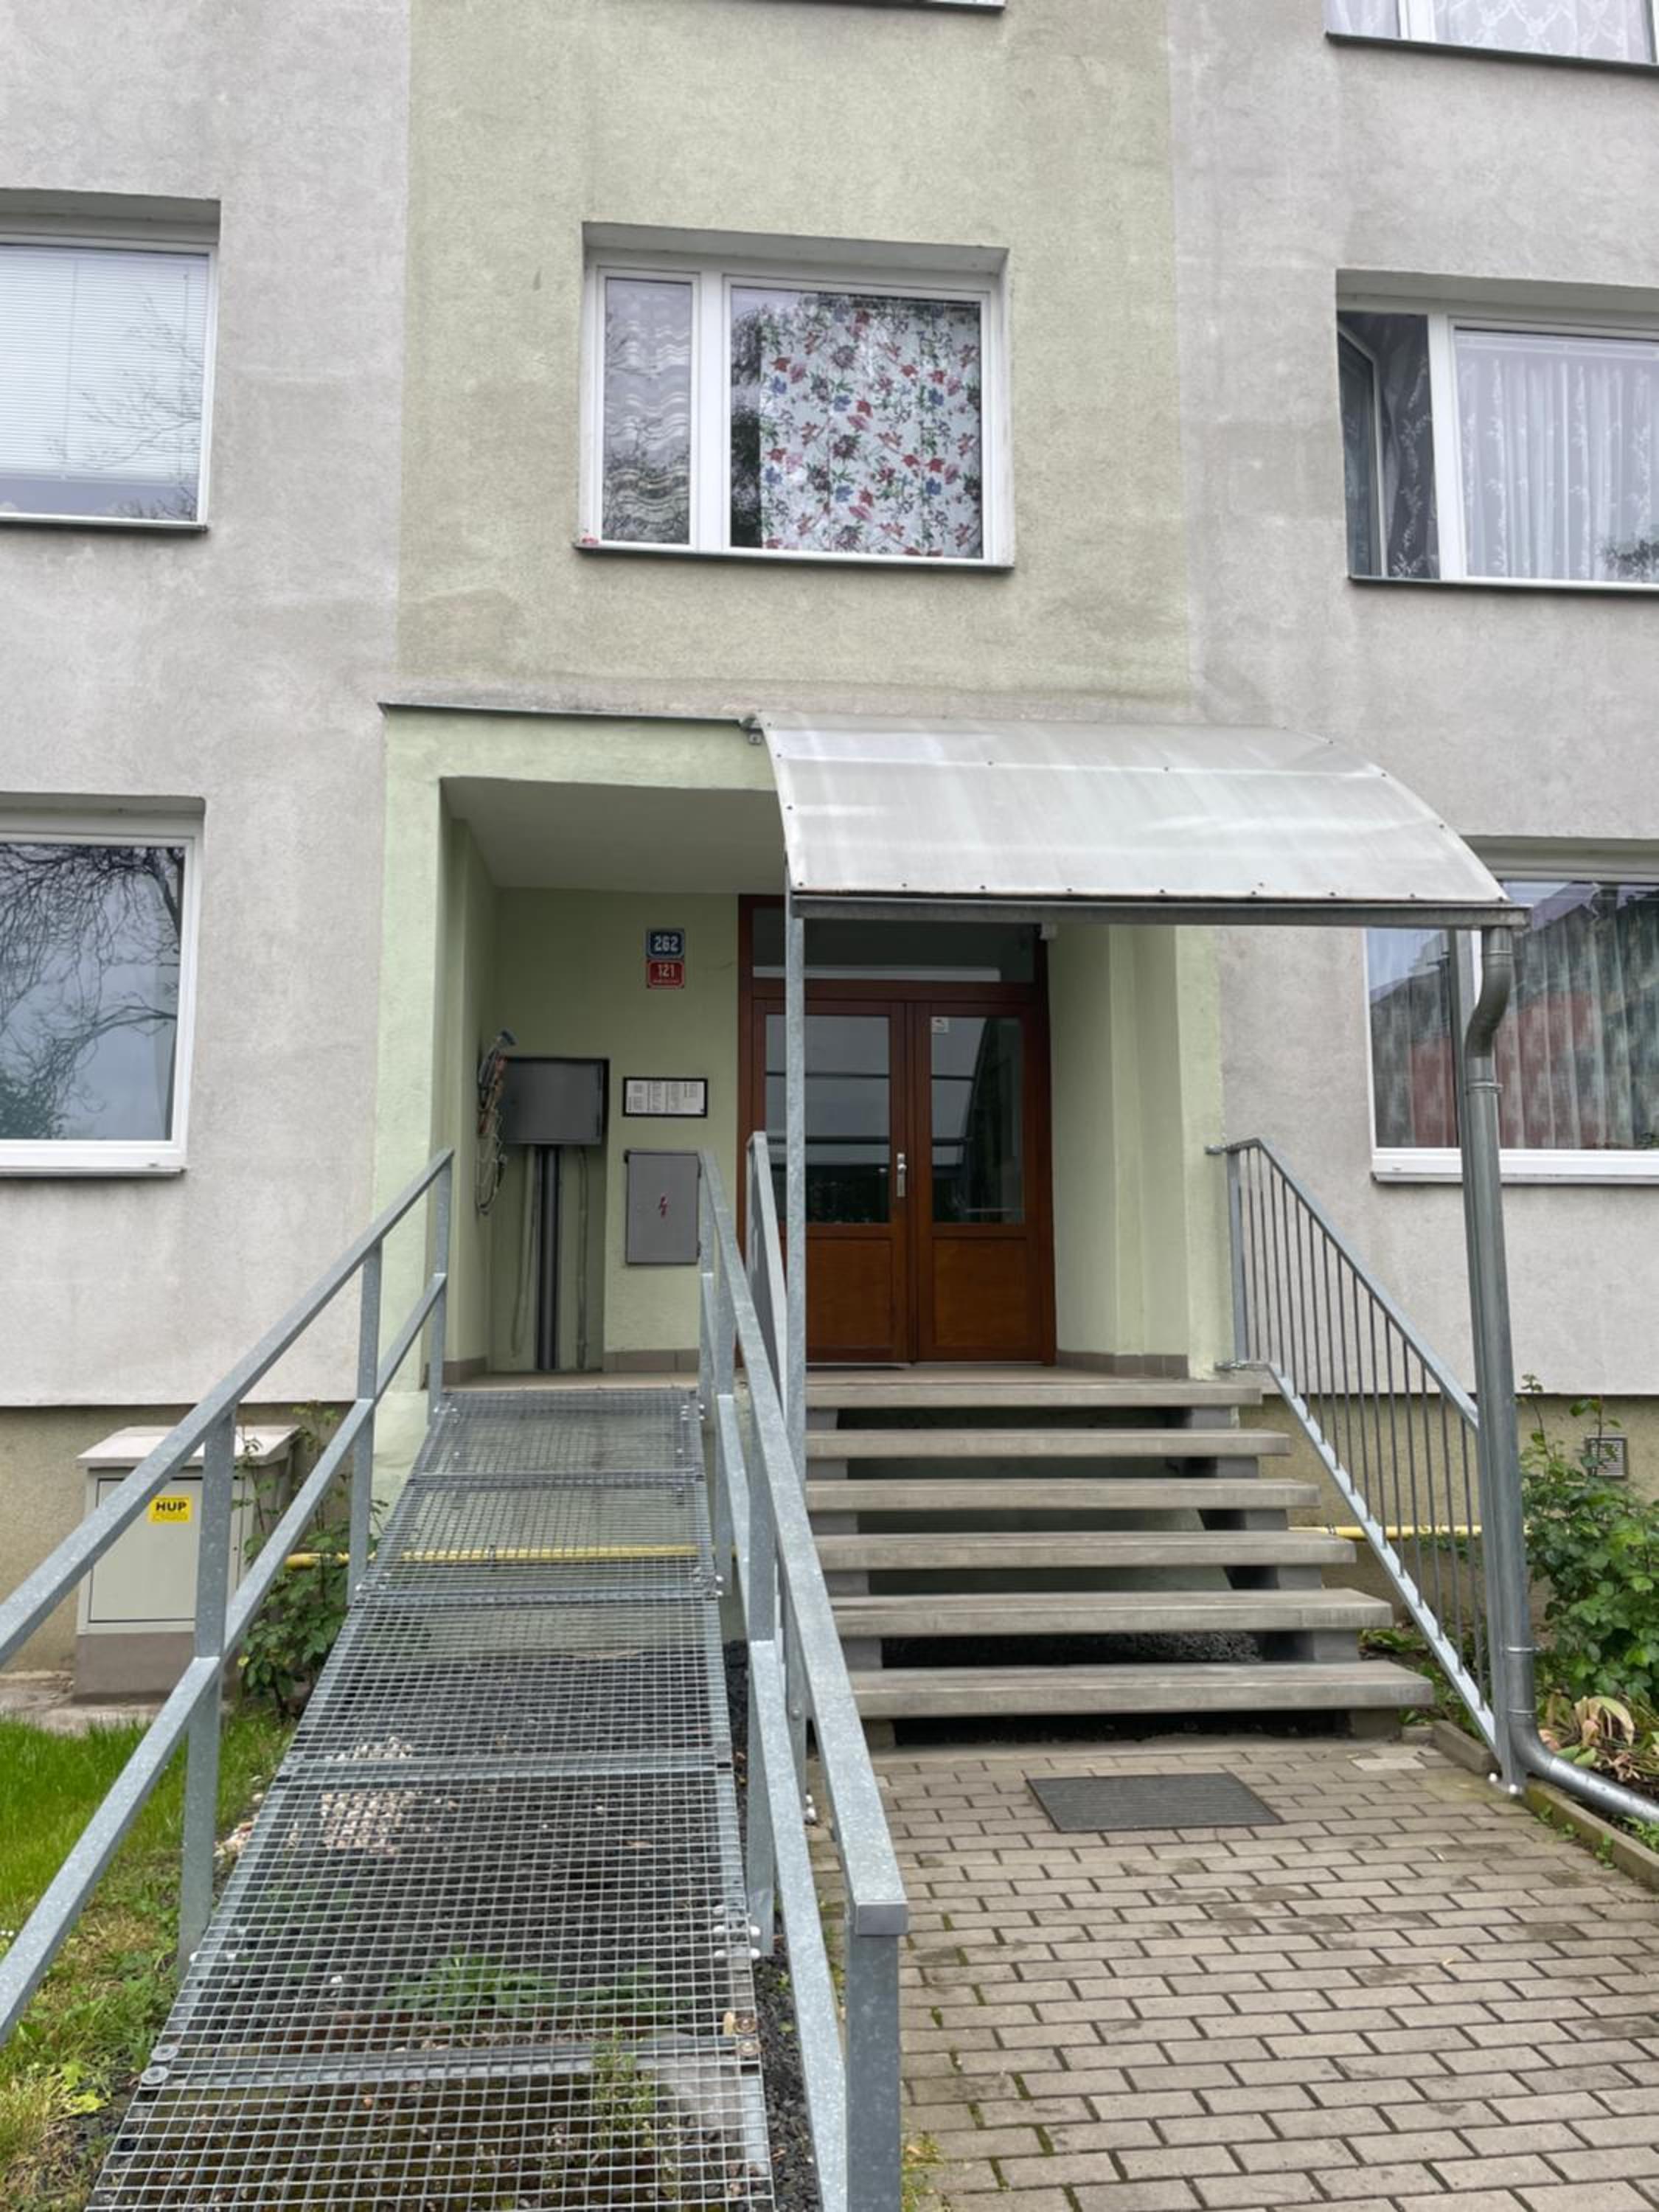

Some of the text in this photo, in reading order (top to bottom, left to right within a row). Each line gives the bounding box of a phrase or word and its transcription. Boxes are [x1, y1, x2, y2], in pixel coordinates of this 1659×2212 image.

[654, 935, 678, 952] 262
[658, 963, 675, 978] 121
[156, 1501, 187, 1512] HUP
